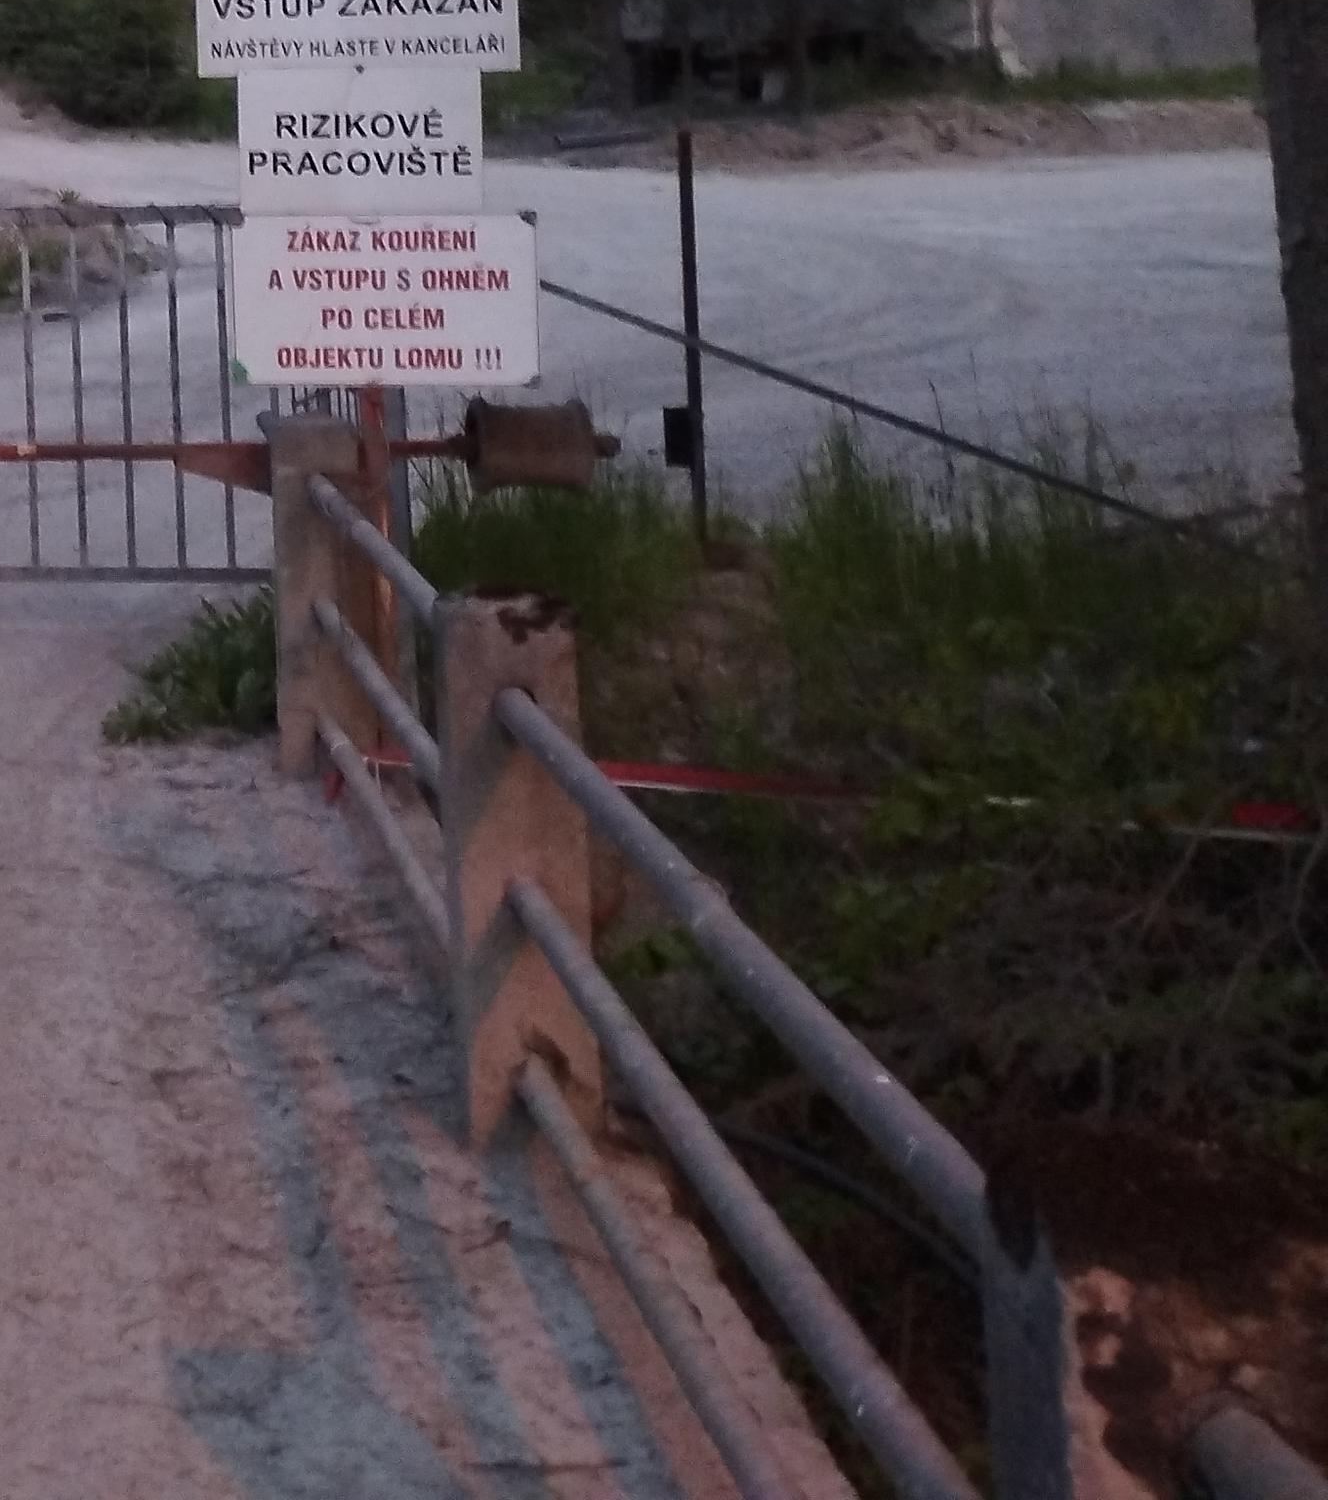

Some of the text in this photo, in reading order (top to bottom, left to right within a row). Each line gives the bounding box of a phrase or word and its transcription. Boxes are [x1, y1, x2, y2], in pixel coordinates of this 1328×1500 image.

[210, 33, 505, 60] NÁVŠTĚVY HLASTE V KANCELÁŘI
[275, 106, 444, 139] RIZIKOVÉ
[248, 145, 472, 176] PRACOVIŠTĚ
[287, 223, 477, 252] ZÁKAZ KOUŘENÍ
[268, 261, 509, 291] A VSTUPU S OHNĚM
[321, 303, 445, 330] PO CELÉM
[277, 346, 502, 371] OBJEKTU LOMU !!!
